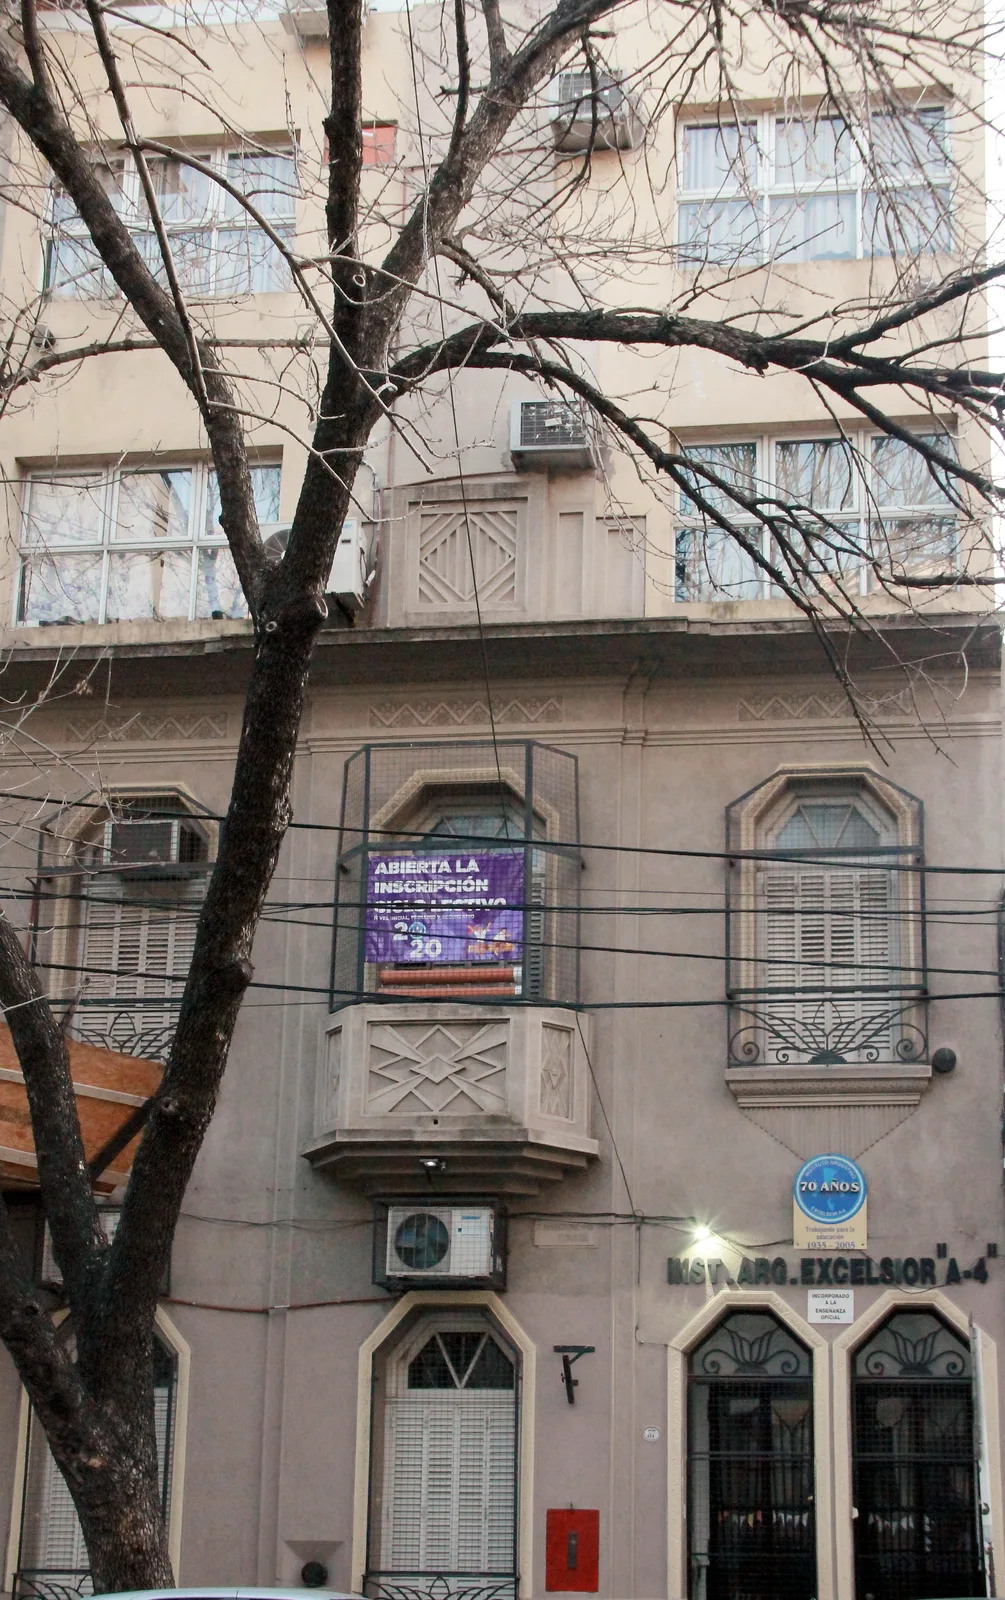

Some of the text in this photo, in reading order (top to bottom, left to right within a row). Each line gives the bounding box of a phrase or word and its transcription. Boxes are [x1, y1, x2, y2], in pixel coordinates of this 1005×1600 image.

[374, 859, 480, 875] ABIERTA LA
[374, 876, 489, 894] INSCRIPCIÓN
[409, 938, 442, 958] 20
[800, 1178, 860, 1193] 70 AÑOS
[807, 1241, 827, 1249] 1935
[835, 1241, 856, 1249] 2005
